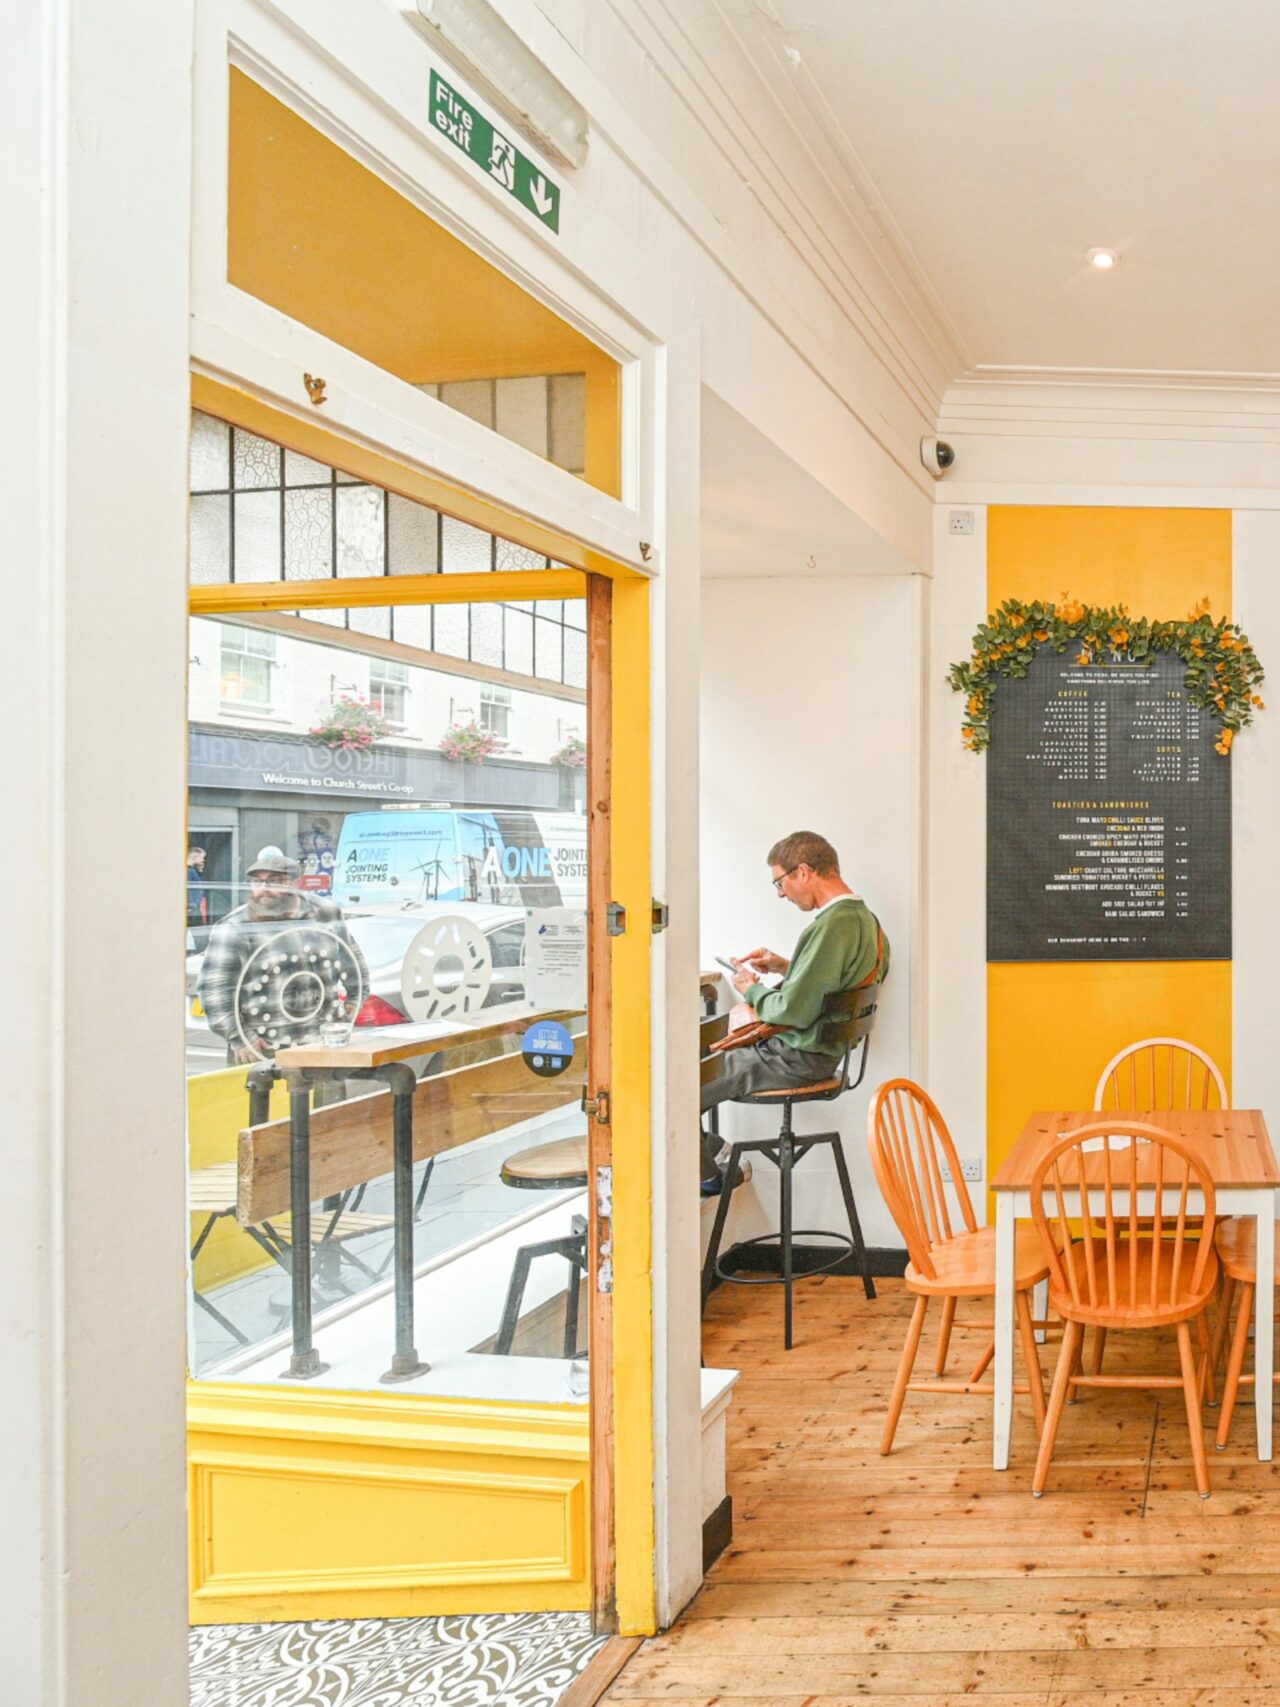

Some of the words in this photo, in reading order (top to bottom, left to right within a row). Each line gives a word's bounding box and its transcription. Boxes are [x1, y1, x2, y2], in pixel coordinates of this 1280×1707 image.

[436, 80, 473, 130] Fire
[435, 110, 471, 152] exit
[262, 773, 309, 786] Welcome
[310, 778, 322, 787] to
[322, 777, 355, 789] Church
[355, 780, 387, 792] Street's
[387, 782, 414, 795] Co-op
[1052, 801, 1090, 809] TOASTIES
[1093, 801, 1097, 809] &
[1100, 801, 1149, 809] SANDWICHES
[1076, 816, 1090, 824] TUNA
[1091, 816, 1107, 824] MAYO
[1107, 816, 1126, 824] CHILLI
[1127, 816, 1144, 824] SAUCE
[1145, 816, 1164, 824] OLIVES
[345, 863, 388, 874] JOINTING
[345, 873, 388, 884] SYSTEMS
